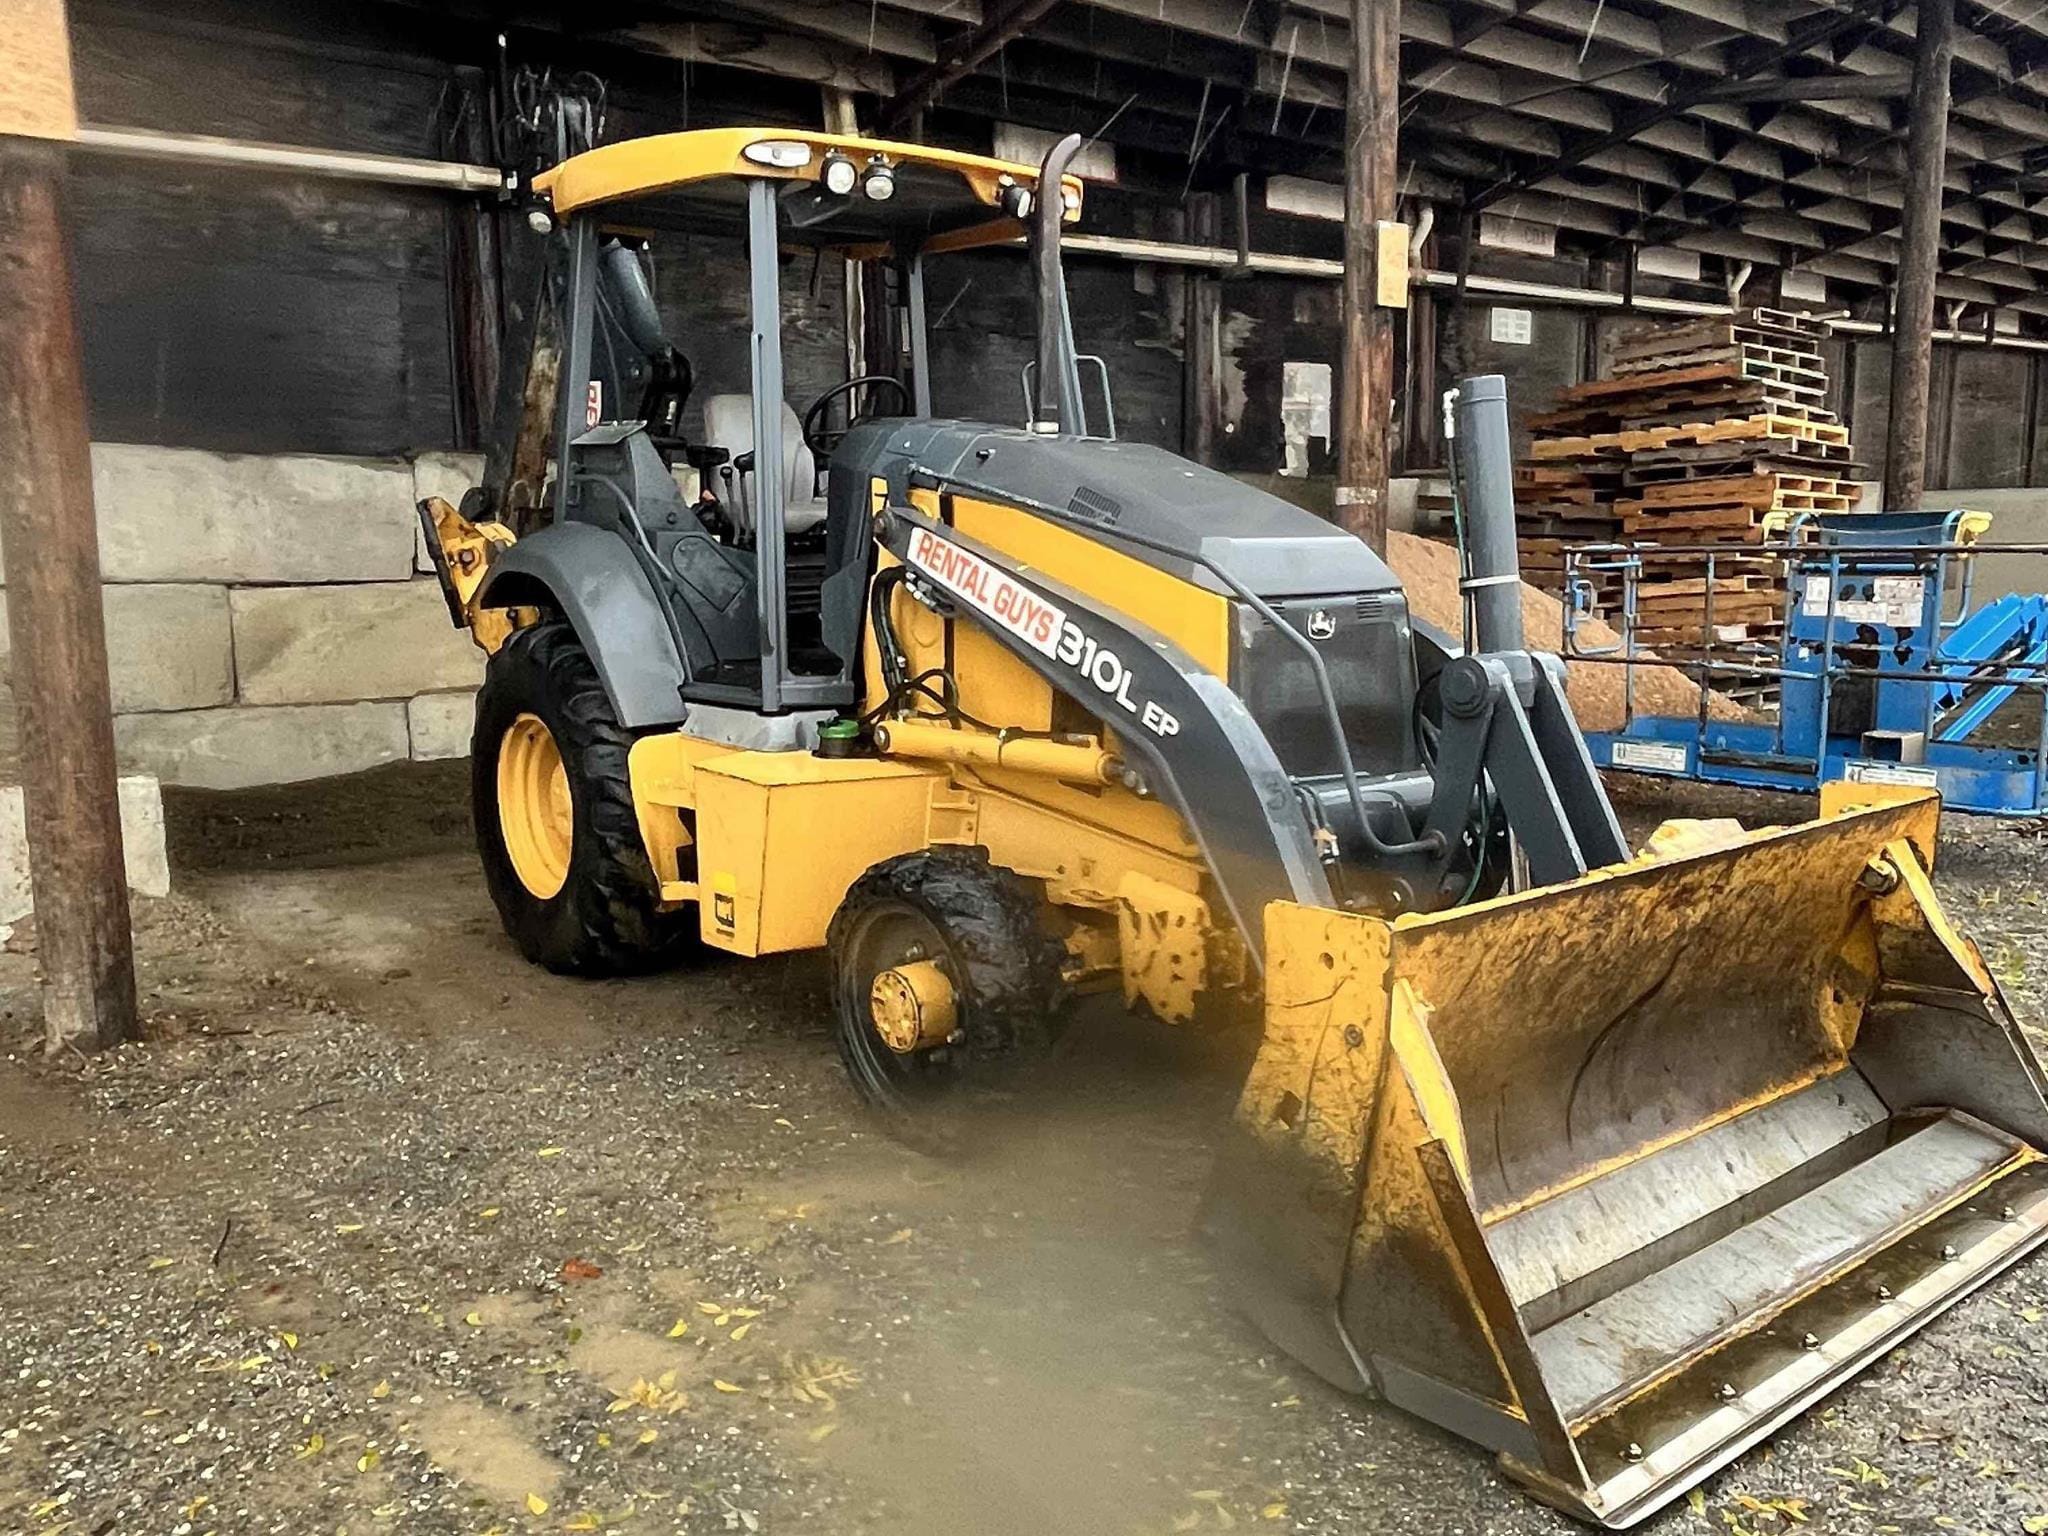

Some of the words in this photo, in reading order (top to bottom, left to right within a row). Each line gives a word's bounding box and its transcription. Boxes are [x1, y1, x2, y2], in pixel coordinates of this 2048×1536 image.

[918, 534, 988, 604] RENTAL
[995, 584, 1055, 641] GUYS
[1057, 622, 1137, 713] 310L
[1142, 701, 1180, 737] EP
